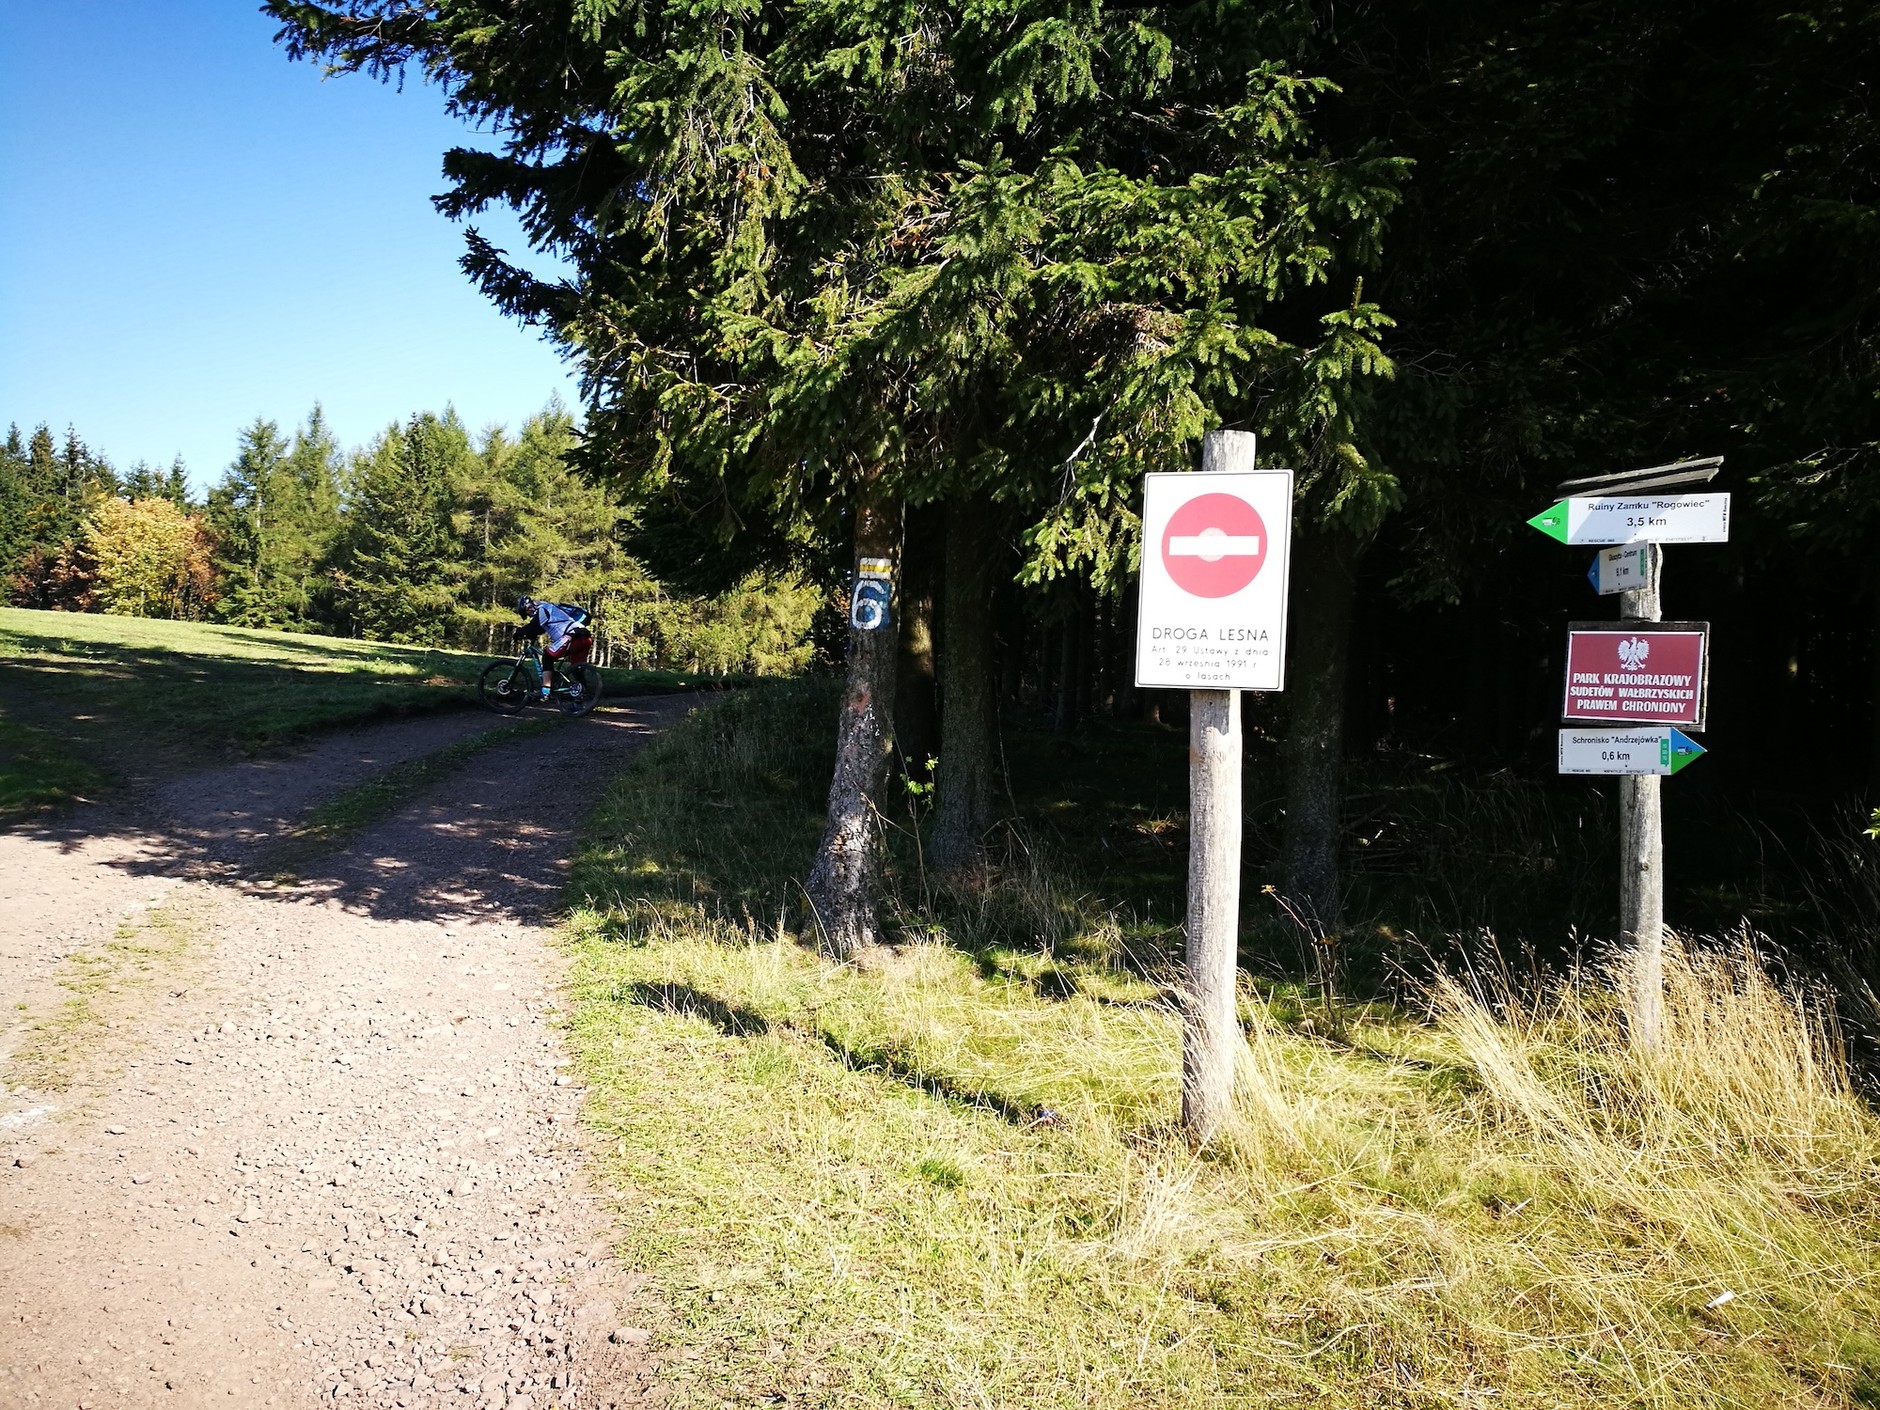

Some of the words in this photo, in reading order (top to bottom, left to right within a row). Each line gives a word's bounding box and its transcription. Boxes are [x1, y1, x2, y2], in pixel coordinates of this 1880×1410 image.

[1588, 502, 1615, 512] Ruiny
[1616, 502, 1649, 510] Zamku
[1652, 499, 1710, 511] "Rogowiec"
[1627, 517, 1645, 527] 3,5
[1648, 517, 1667, 526] km
[1152, 627, 1209, 640] DROGA
[1175, 645, 1188, 654] 29
[1193, 646, 1229, 657] Ustawy
[1245, 647, 1269, 656] dnia
[1158, 658, 1171, 666] 28
[1226, 659, 1247, 668] 1991
[1197, 672, 1231, 681] lasach
[1573, 673, 1600, 684] PARK
[1604, 673, 1692, 687] KRAJOBRAZOWY
[1570, 685, 1614, 698] SUDETÓW
[1618, 687, 1694, 700] WAŁBRZYSKICH
[1576, 699, 1618, 711] PRAWEM
[1621, 700, 1687, 713] CHRONIONY
[1572, 736, 1610, 744] Schronisko
[1611, 735, 1662, 745] "Andrzejówka"
[1601, 751, 1615, 761] 0,6
[1616, 751, 1631, 760] km
